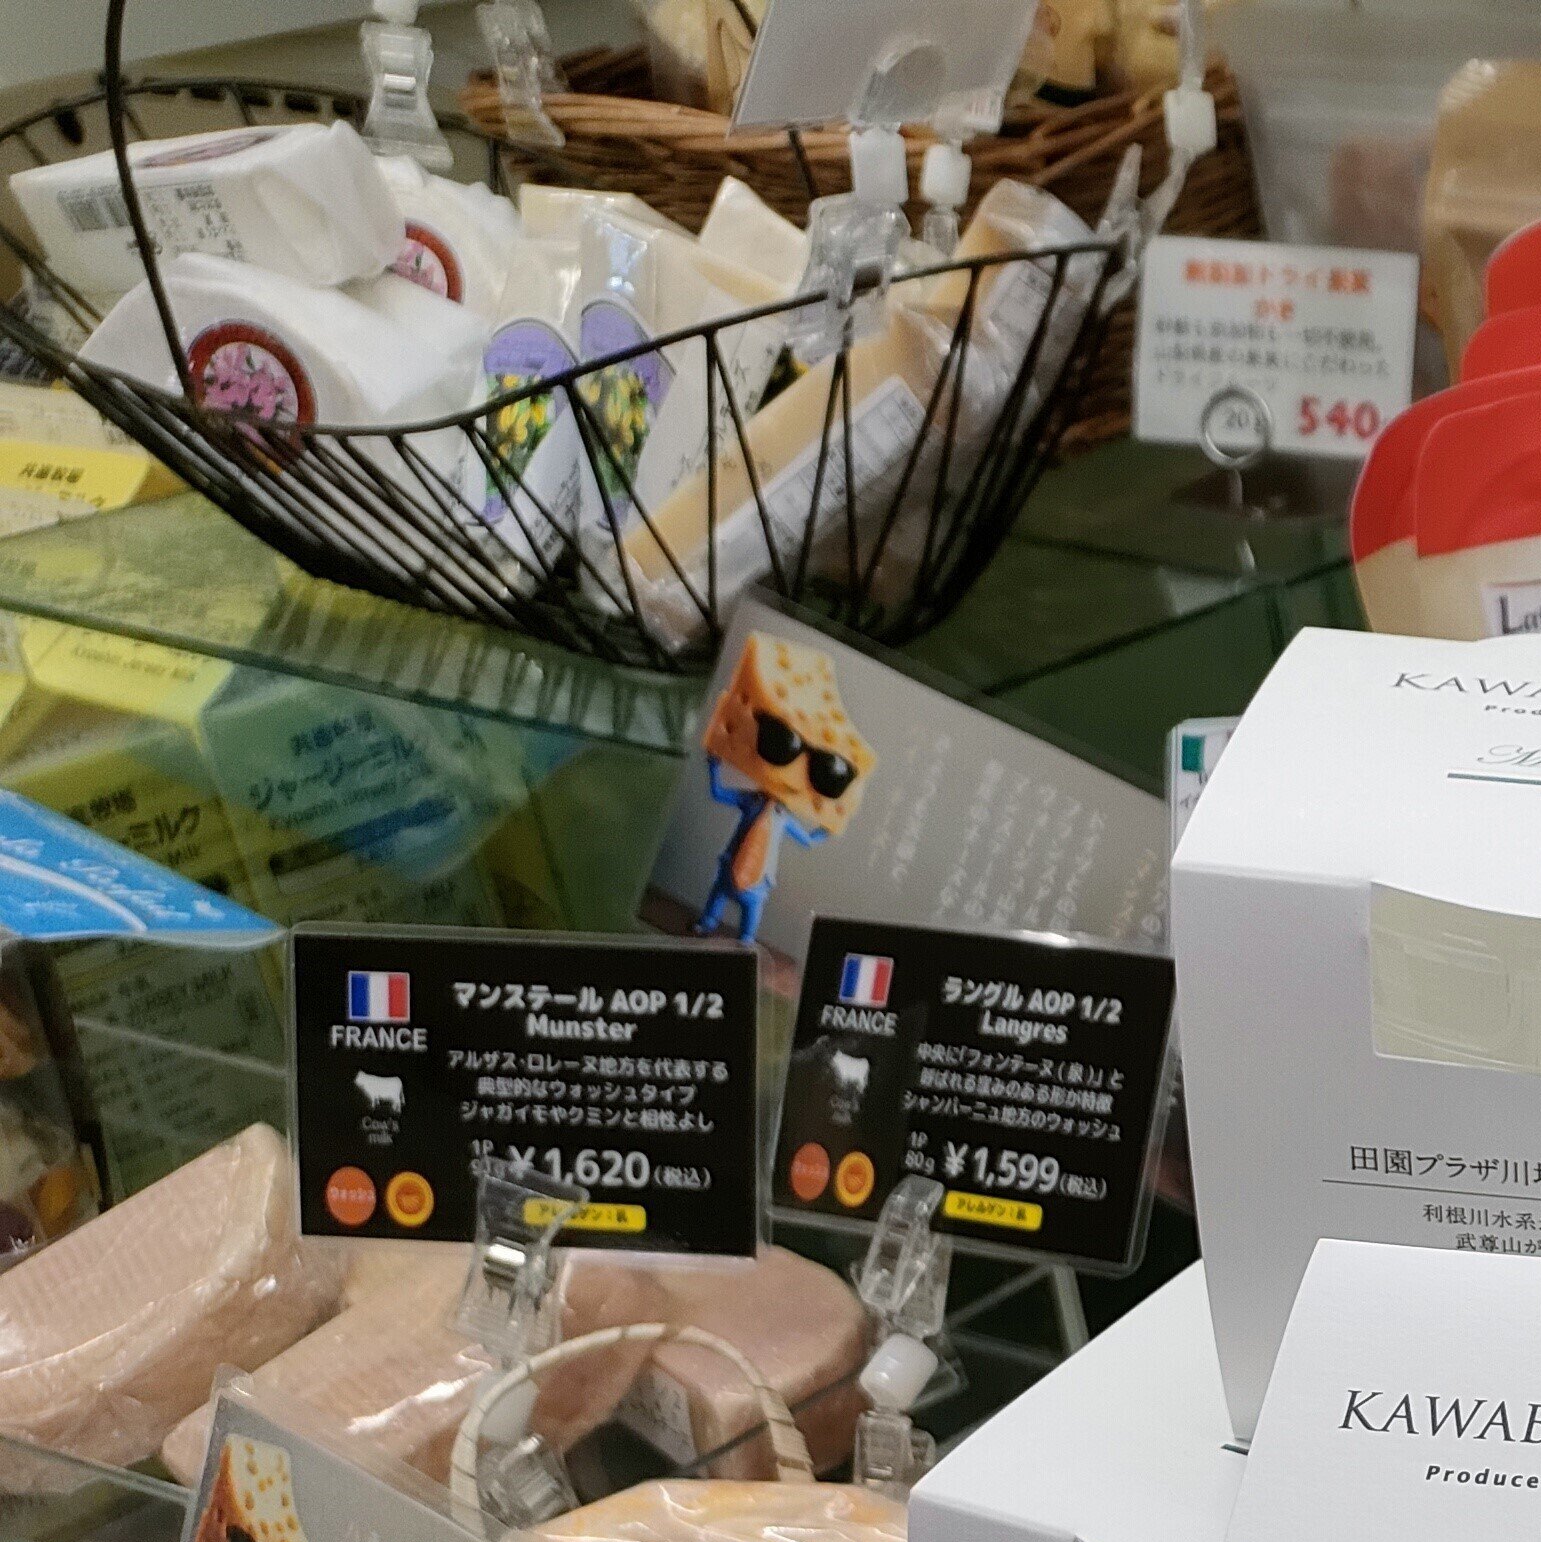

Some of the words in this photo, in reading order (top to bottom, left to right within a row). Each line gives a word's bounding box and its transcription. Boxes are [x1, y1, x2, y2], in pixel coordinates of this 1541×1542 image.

[1298, 396, 1382, 438] 540
[453, 981, 603, 1014] マンステール
[611, 993, 666, 1014] AOP
[673, 991, 725, 1018] 1/2
[942, 975, 1024, 1010] ラングル
[1028, 989, 1076, 1015] AOP
[1079, 994, 1123, 1025] 1/2
[330, 1025, 428, 1051] FRANCE
[526, 1016, 637, 1041] Munster
[820, 1004, 899, 1037] FRANCE
[981, 1011, 1069, 1046] Langres
[476, 1076, 696, 1105] 典型的なウォッシュタイプ
[460, 1102, 714, 1133] ジャガイモやクミンと相性よし
[903, 1090, 1122, 1142] シャンパーニュ地方のウォッシュ
[507, 1144, 651, 1188] ¥1,620
[943, 1140, 1060, 1193] ¥1,599
